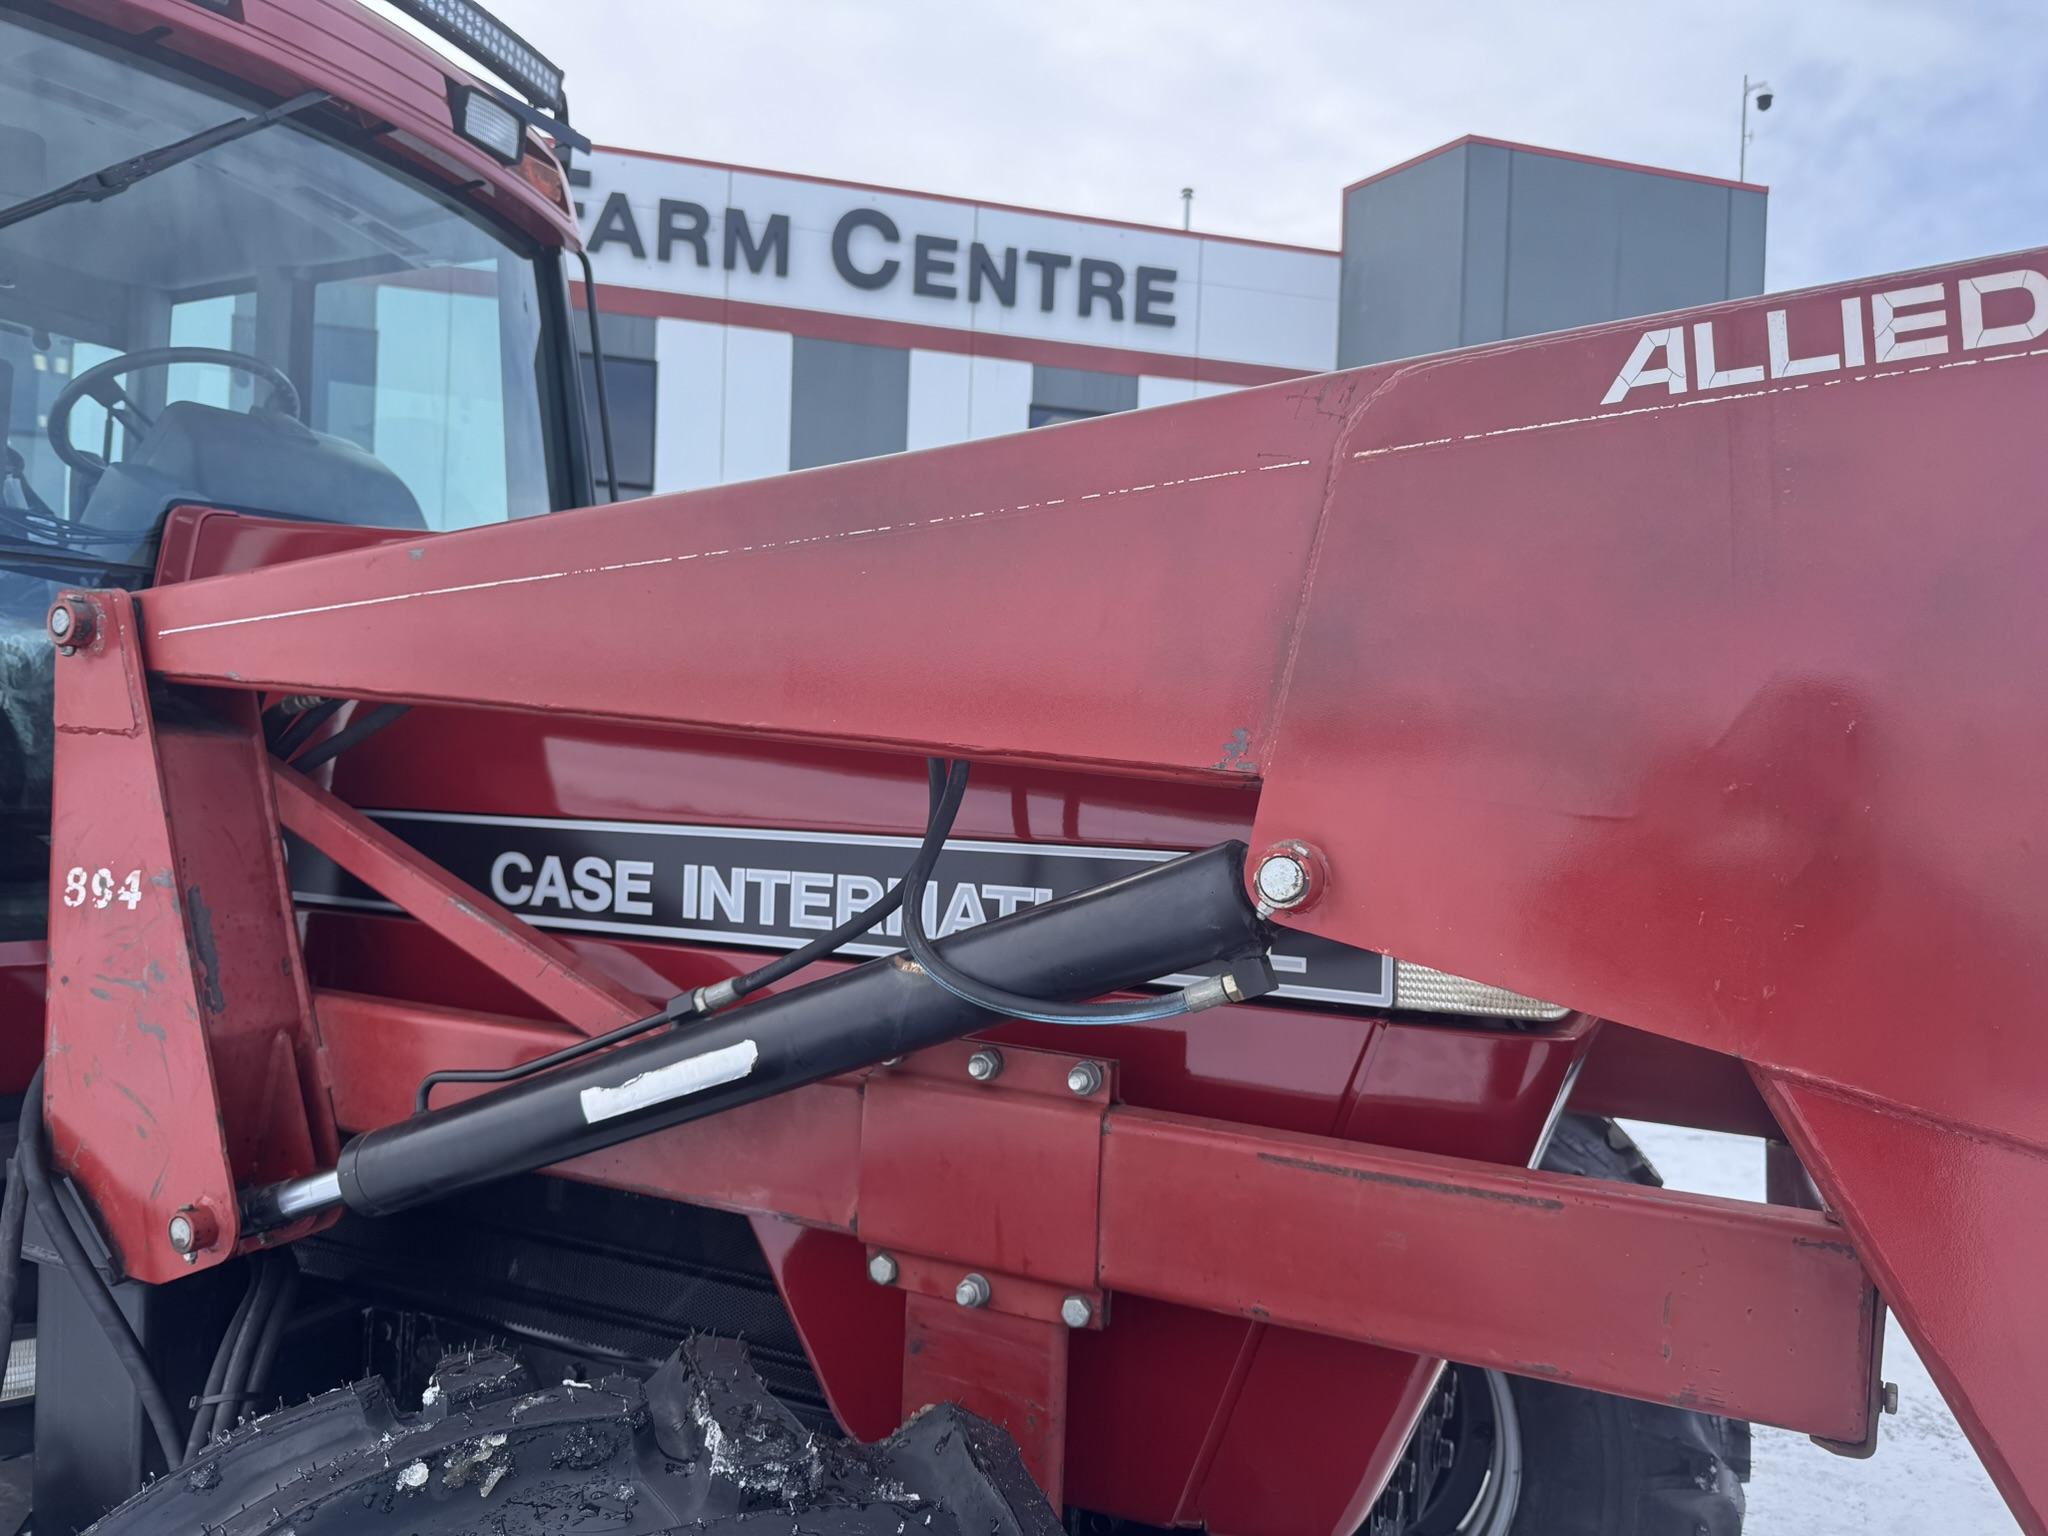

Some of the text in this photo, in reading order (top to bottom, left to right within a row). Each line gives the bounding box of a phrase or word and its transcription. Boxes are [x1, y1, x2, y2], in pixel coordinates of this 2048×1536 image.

[831, 207, 1178, 327] CENTRE
[1600, 269, 2048, 405] ALLIED
[63, 867, 142, 910] 894
[490, 851, 655, 917] CASE
